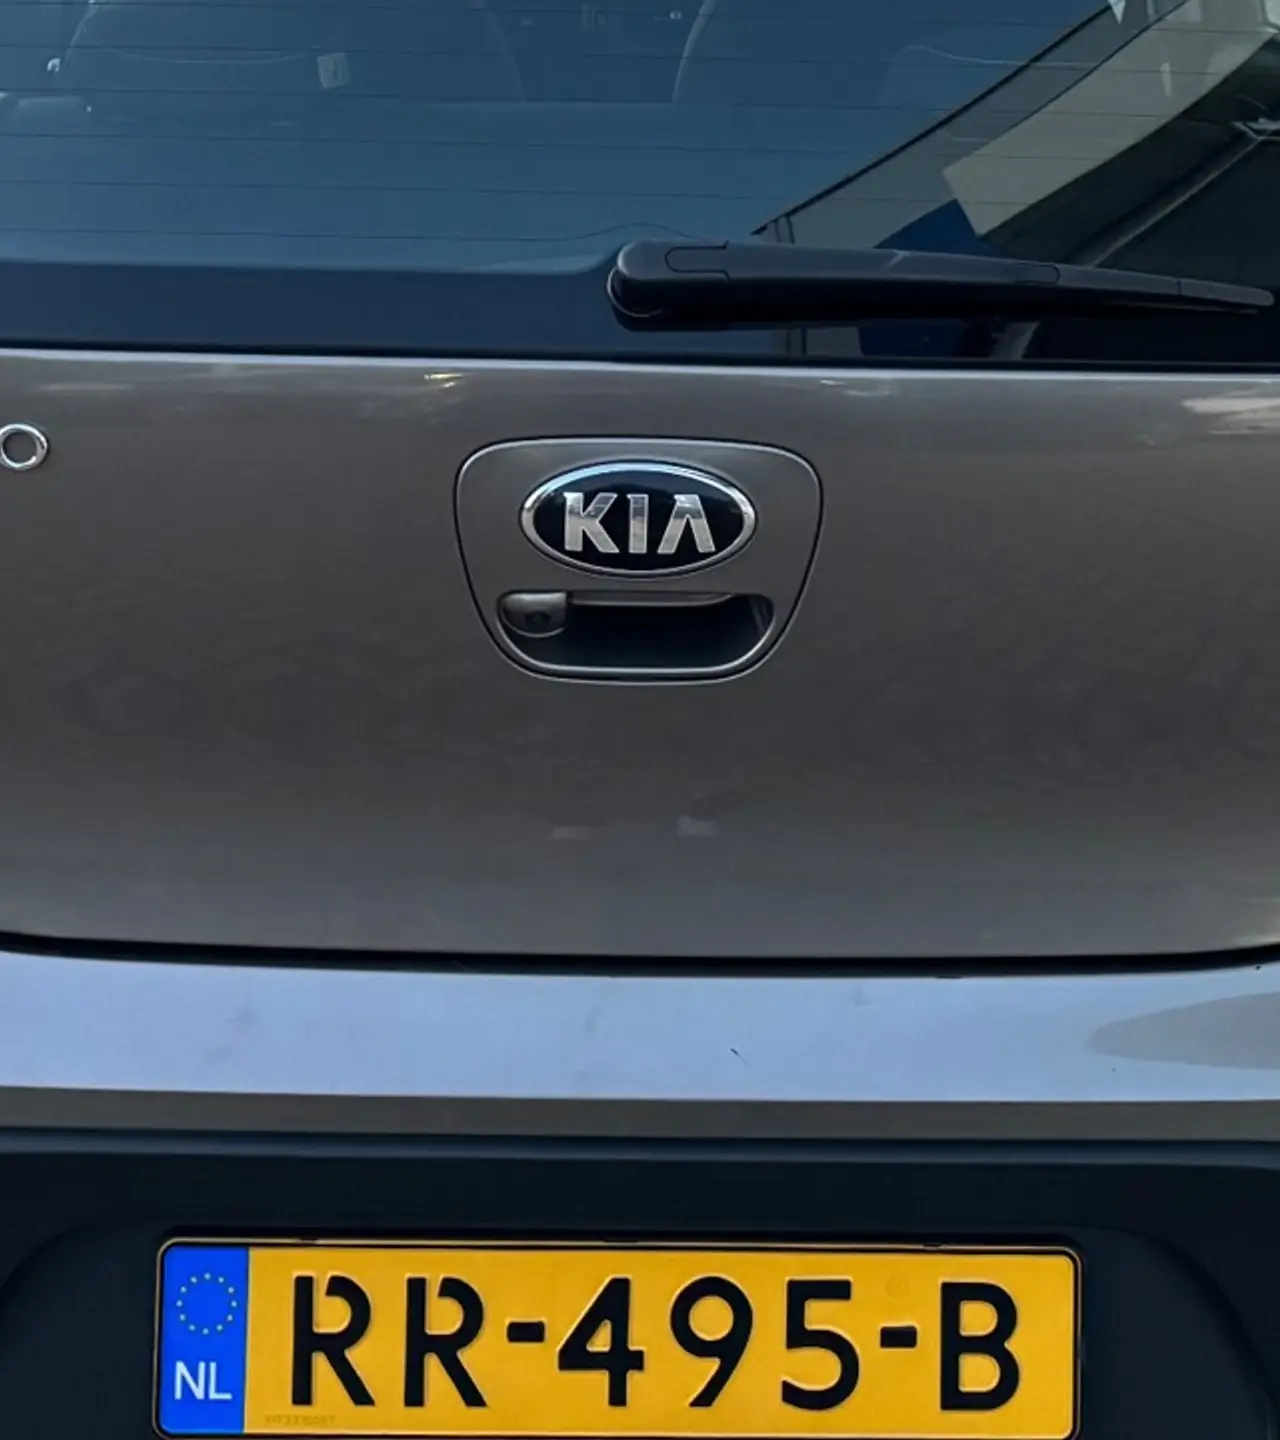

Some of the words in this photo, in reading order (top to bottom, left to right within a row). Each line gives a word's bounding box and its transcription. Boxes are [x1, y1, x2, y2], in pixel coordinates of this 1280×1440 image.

[562, 491, 716, 554] KIA
[291, 1273, 1021, 1412] RR-495-B
[174, 1360, 233, 1401] NL
